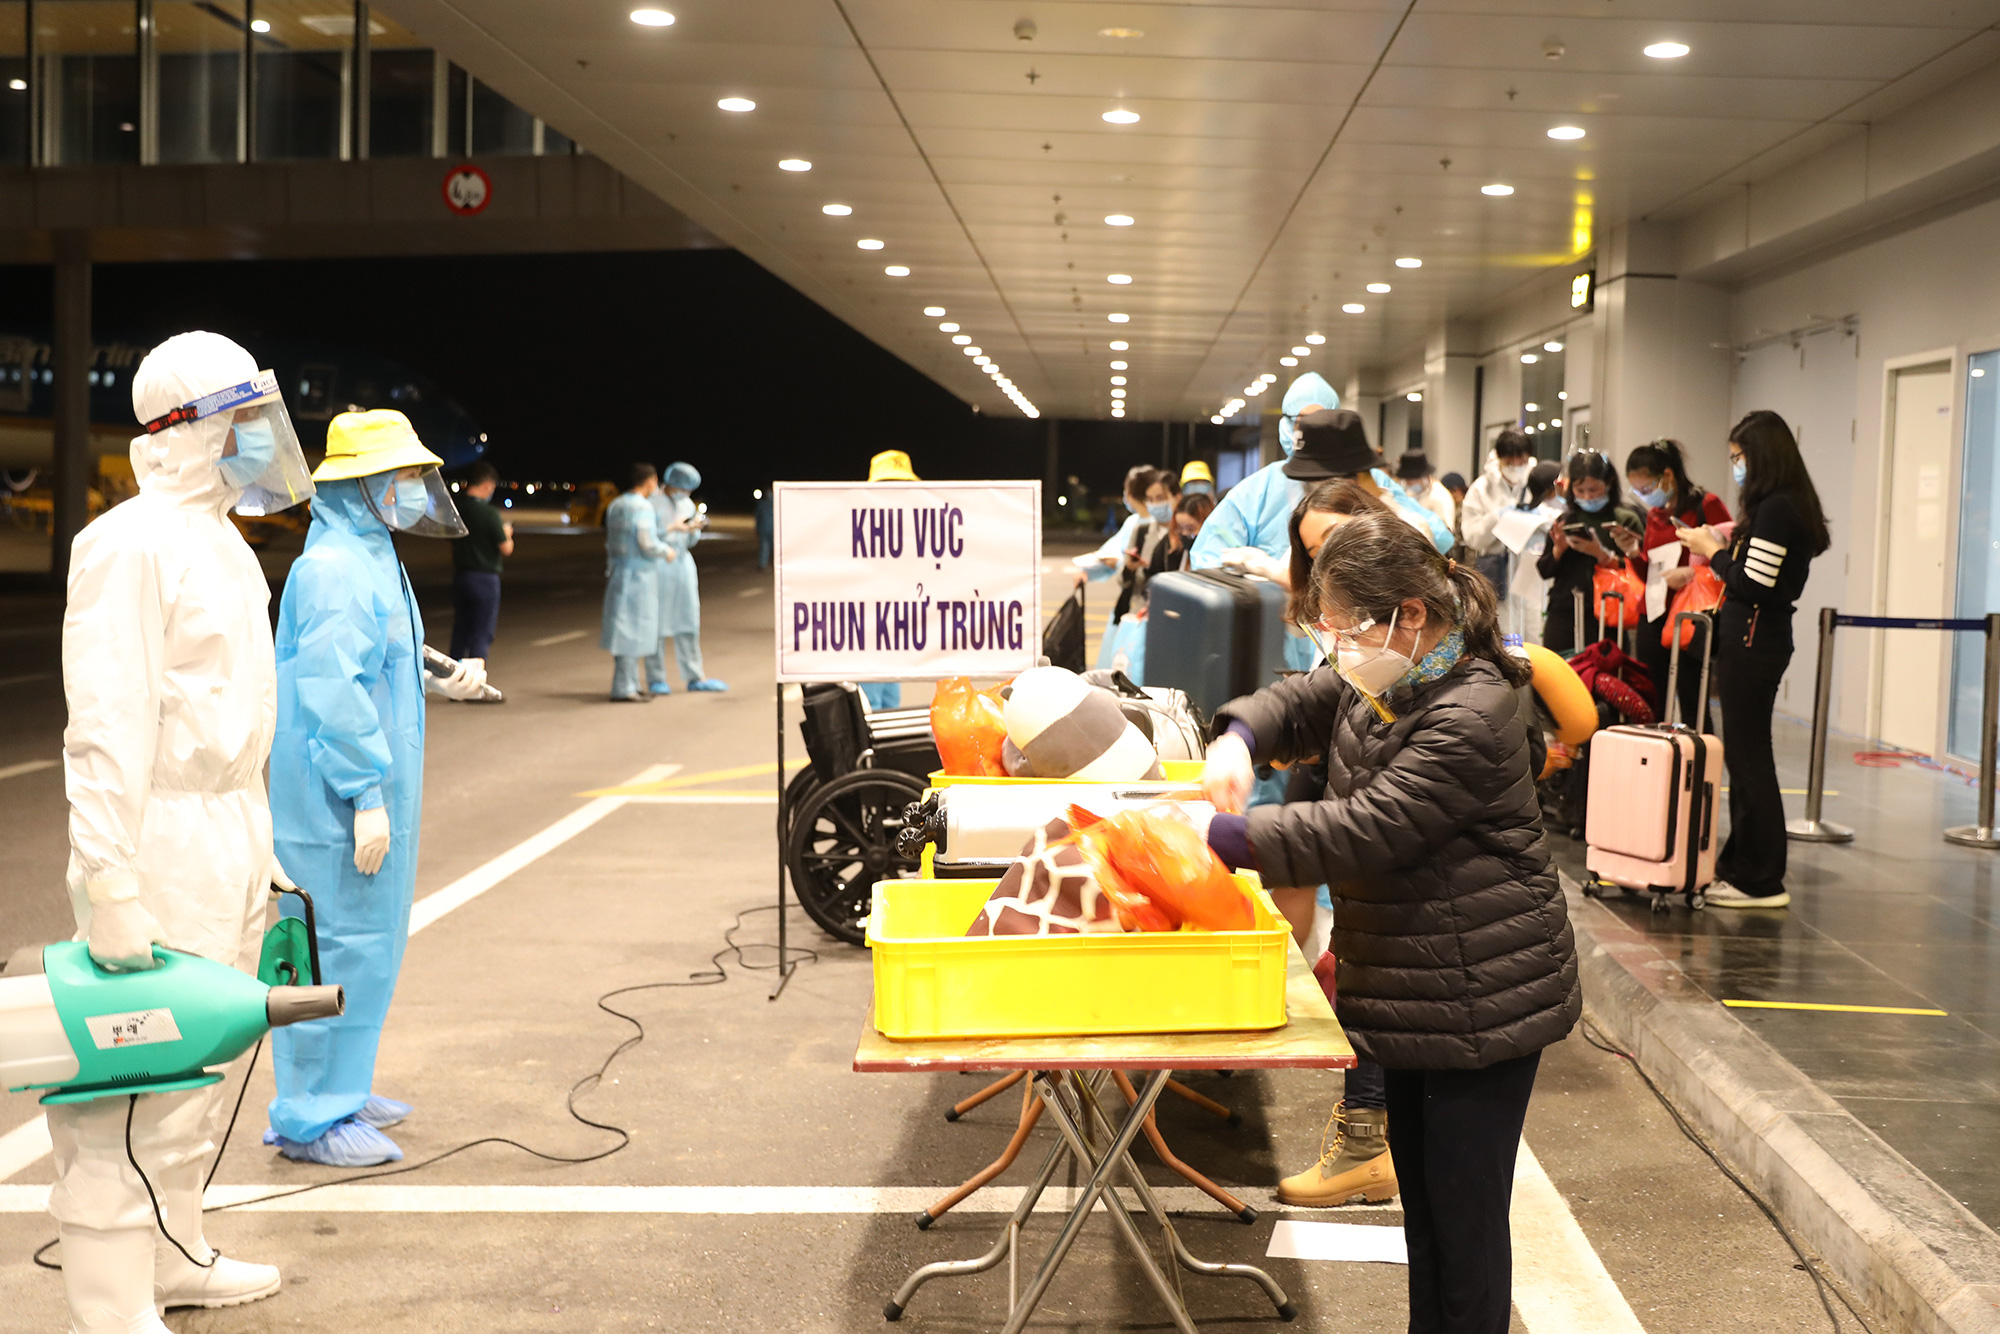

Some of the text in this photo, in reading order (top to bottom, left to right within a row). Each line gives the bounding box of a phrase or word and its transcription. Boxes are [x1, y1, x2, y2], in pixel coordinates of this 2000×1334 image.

[852, 502, 963, 569] KHU VỰC
[793, 583, 1023, 651] PHUN KHỬ TRÙNG
